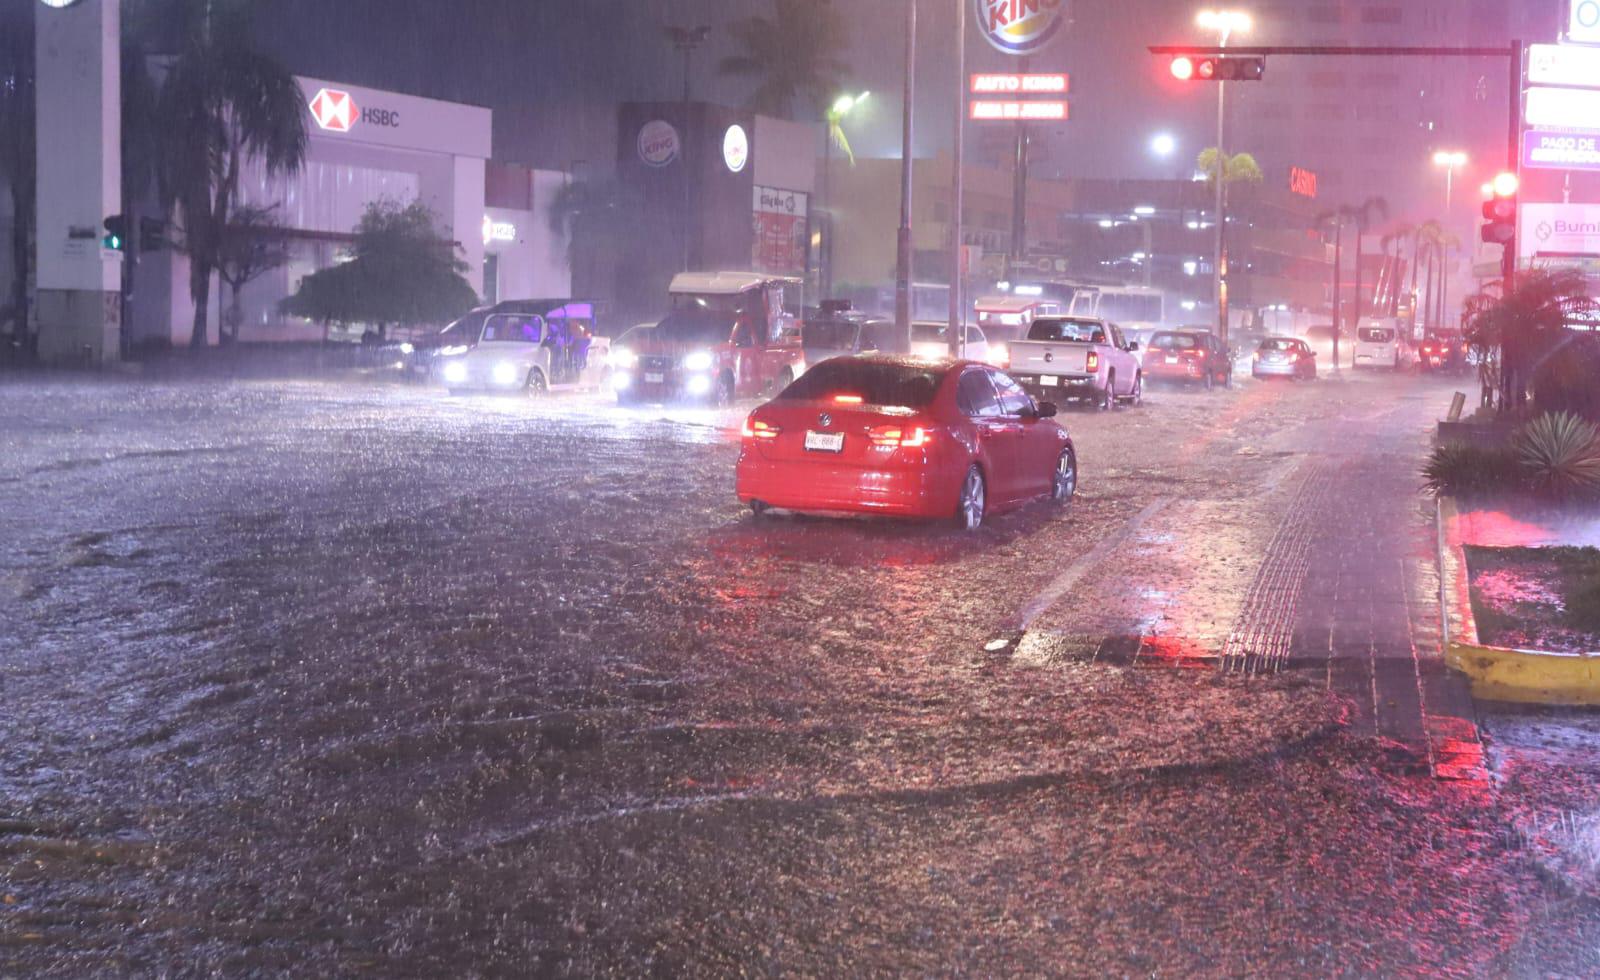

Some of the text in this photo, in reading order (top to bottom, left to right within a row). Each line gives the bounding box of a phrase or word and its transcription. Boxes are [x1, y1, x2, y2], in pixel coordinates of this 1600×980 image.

[975, 76, 1019, 91] AUTO
[361, 106, 400, 128] HSBC
[1541, 137, 1596, 151] PAGO DE
[1291, 167, 1317, 198] CASINO
